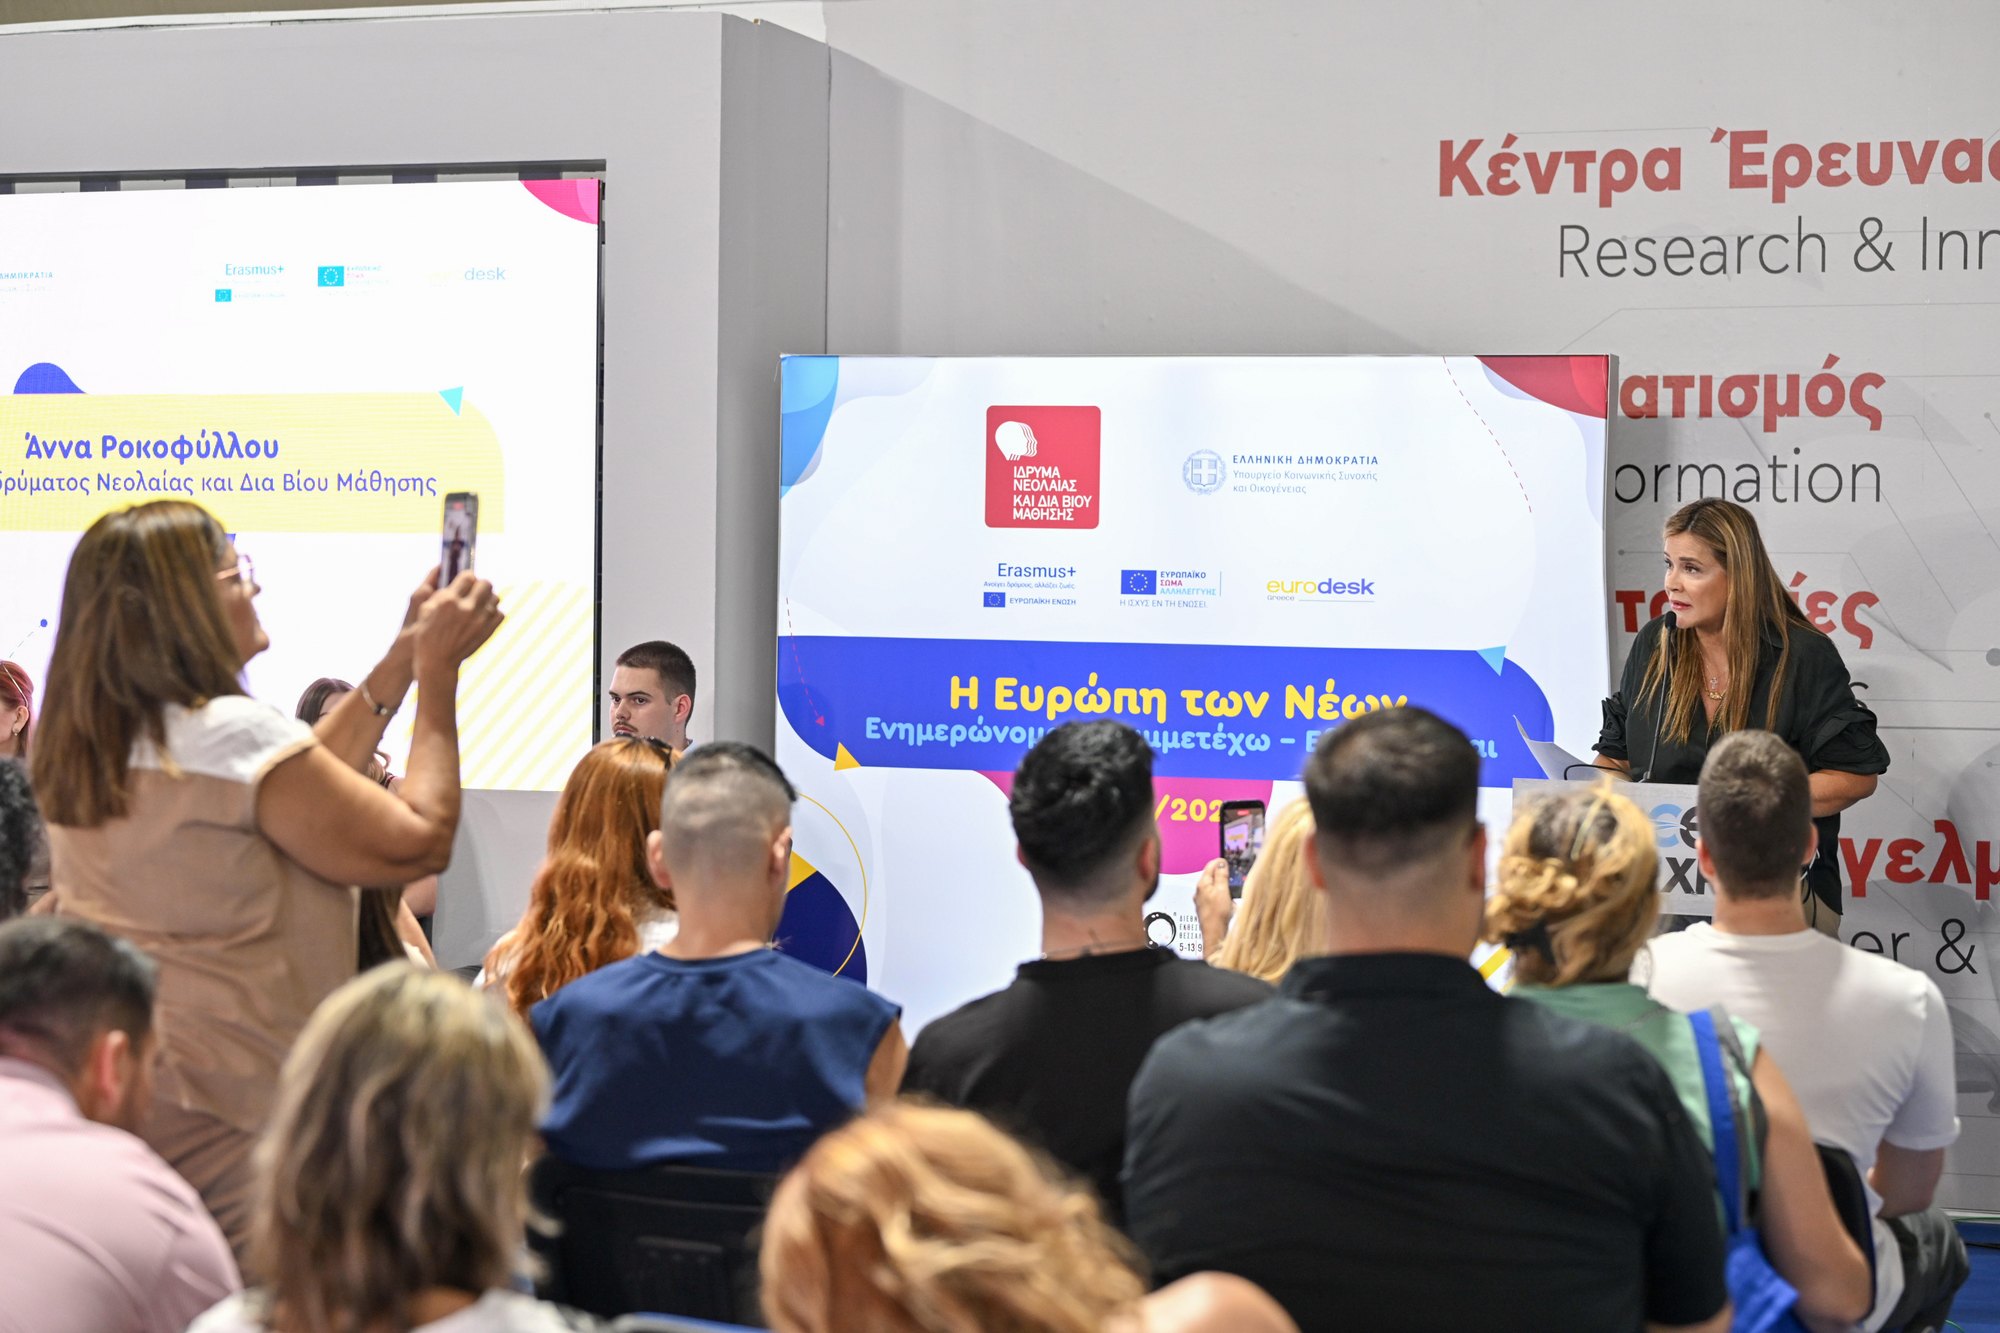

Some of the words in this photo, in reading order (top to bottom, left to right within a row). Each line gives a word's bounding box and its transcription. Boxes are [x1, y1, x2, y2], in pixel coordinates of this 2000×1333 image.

[1439, 133, 1681, 208] Κέντρα
[1559, 216, 1826, 278] Research
[1853, 216, 1896, 273] &
[1922, 216, 2000, 271] Inn
[225, 263, 285, 276] Erasmus+
[1619, 353, 1886, 433] ατισμός
[25, 432, 93, 460] Άννα
[102, 429, 279, 466] Ροκοφύλλου
[1233, 454, 1293, 464] ΕΛΛΗΝΙΚΗ
[1298, 455, 1379, 465] ΔΗΜΟΚΡΑΤΙΑ
[1013, 465, 1061, 479] ΙΔΡΥΜΑ
[1233, 470, 1282, 481] Υπουργείο
[1284, 470, 1337, 481] Κοινωνικής
[1338, 471, 1378, 482] Συνοχής
[1614, 446, 1881, 504] ormation
[97, 469, 194, 496] Νεολαίας
[202, 476, 234, 492] και
[240, 472, 275, 492] Δια
[283, 469, 328, 492] Βίου
[337, 469, 437, 497] Μάθησης
[1013, 479, 1078, 492] ΝΕΟΛΑΙΑΣ
[1233, 485, 1247, 493] και
[1250, 484, 1307, 495] Οικογένειας
[1013, 494, 1035, 507] ΚΑΙ
[1037, 495, 1060, 508] ΔΙΑ
[1062, 495, 1093, 508] ΒΙΟΥ
[1013, 507, 1075, 521] ΜΑΘΗΣΗΣ
[998, 562, 1077, 579] Erasmus+
[1160, 570, 1207, 579] ΕΥΡΩΠΑΪΚΟ
[1160, 579, 1183, 587] ΣΩΜΑ
[1266, 577, 1375, 595] eurodesk
[1052, 598, 1077, 606] ΕΝΩΣΗ
[1119, 599, 1126, 607] Η
[1151, 600, 1163, 608] ΕΝ
[950, 675, 979, 710] Η
[995, 672, 1167, 724] Ευρώπη
[1181, 688, 1270, 719] των
[865, 715, 1056, 750] Ενημερώνομ
[1137, 722, 1271, 757] μμετέχω
[1935, 917, 1978, 975] &
